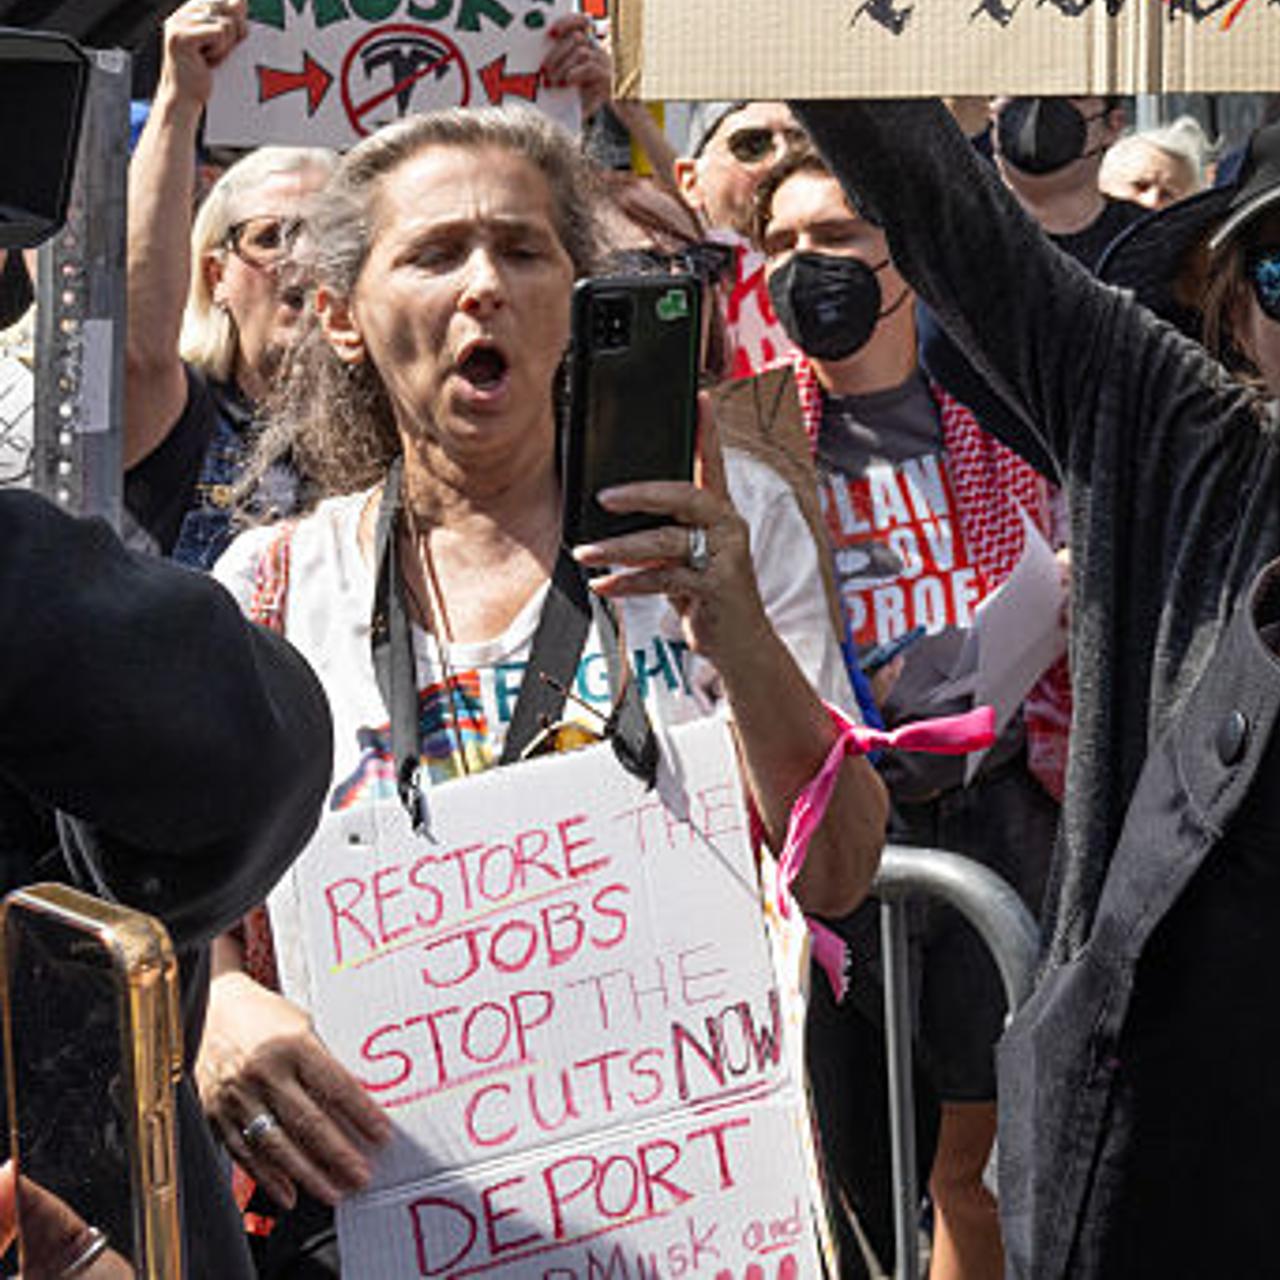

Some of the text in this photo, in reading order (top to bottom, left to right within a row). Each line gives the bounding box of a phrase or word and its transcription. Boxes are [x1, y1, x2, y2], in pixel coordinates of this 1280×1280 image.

[323, 815, 611, 966] RESTORE
[421, 884, 632, 988] JOBS
[359, 943, 729, 1092] STOP THE
[408, 1118, 750, 1275] DEPORT
